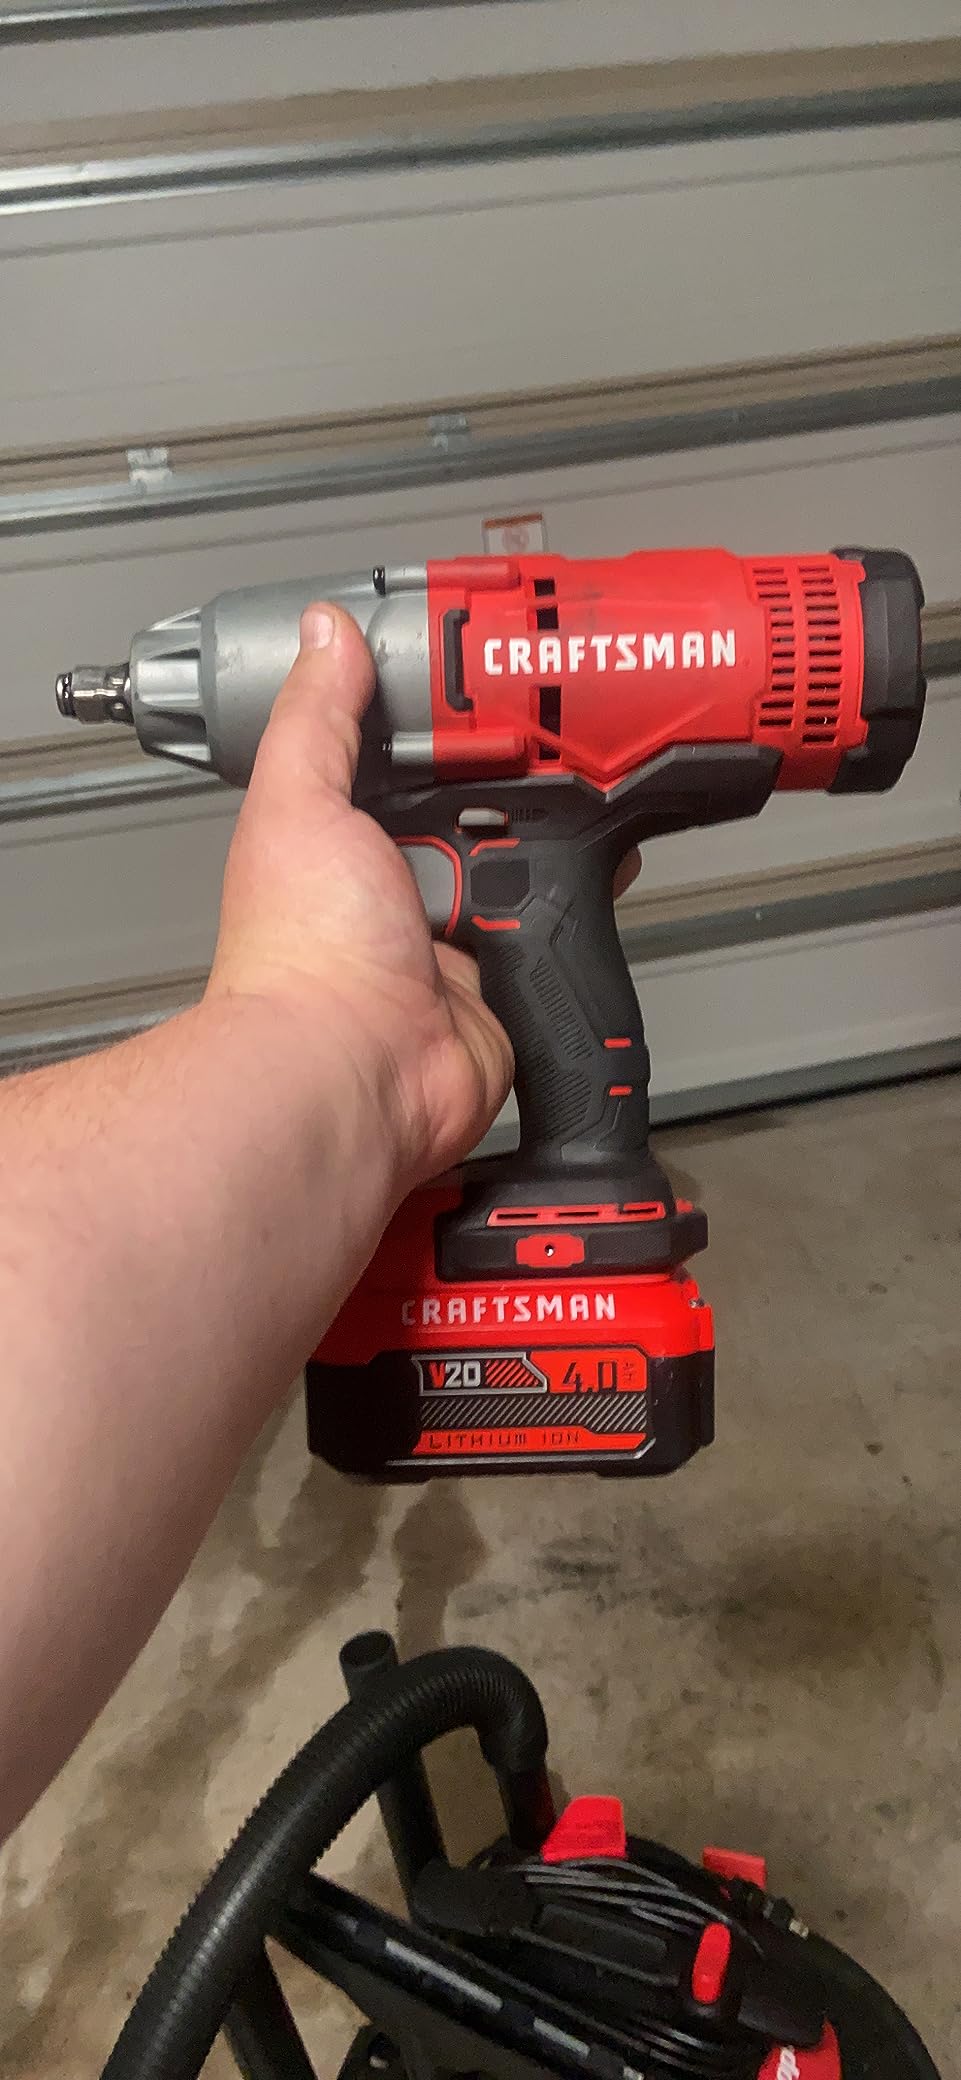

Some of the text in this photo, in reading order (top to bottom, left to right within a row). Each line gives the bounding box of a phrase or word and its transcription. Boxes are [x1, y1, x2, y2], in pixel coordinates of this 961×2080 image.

[483, 628, 736, 676] CRAFTSMAN
[401, 1293, 616, 1326] CRAFTSMAN
[429, 1360, 481, 1389] V20
[562, 1361, 618, 1393] 4.0
[429, 1430, 580, 1450] LITHIUM ION
